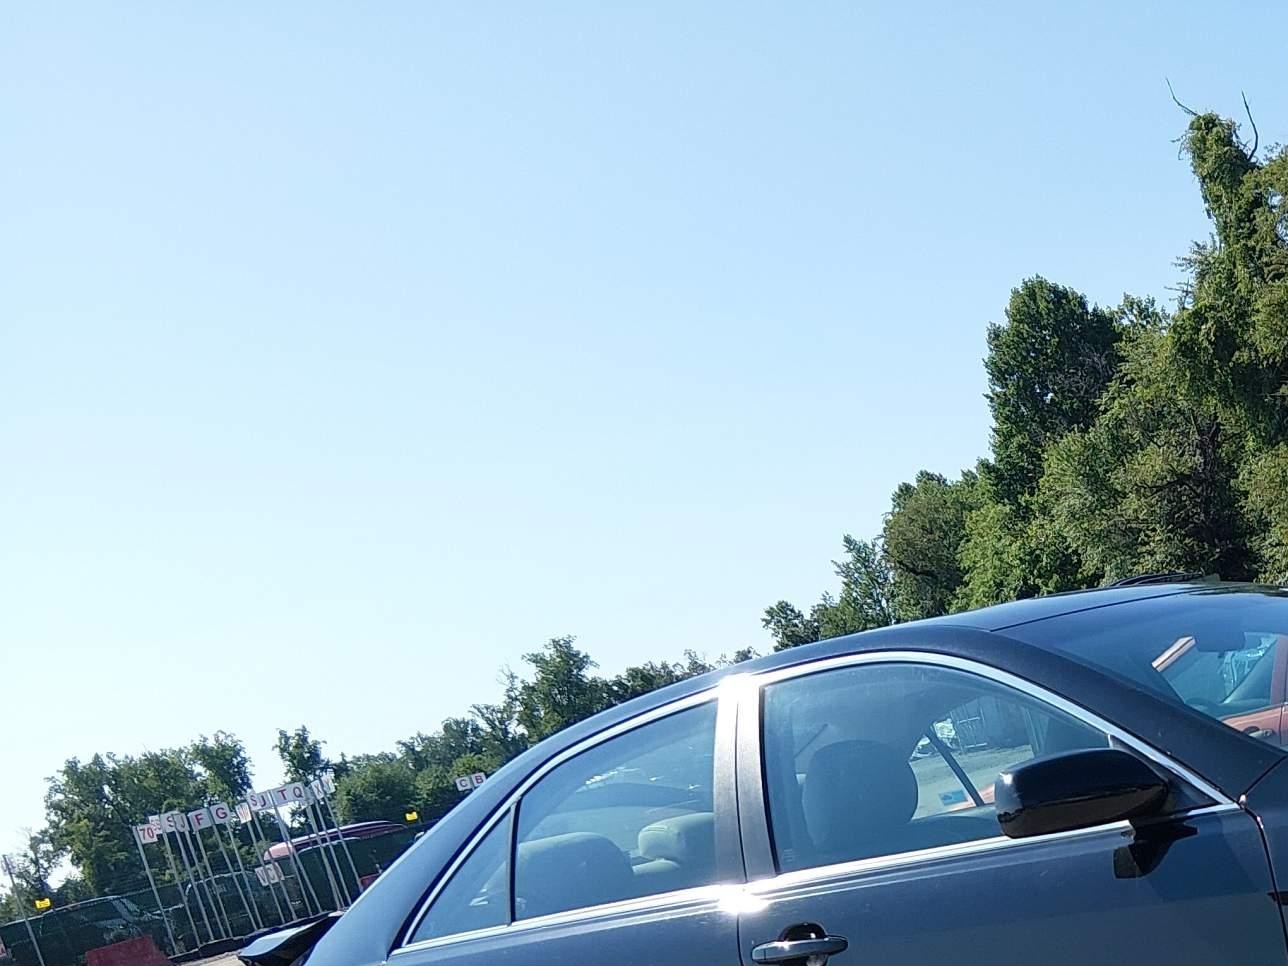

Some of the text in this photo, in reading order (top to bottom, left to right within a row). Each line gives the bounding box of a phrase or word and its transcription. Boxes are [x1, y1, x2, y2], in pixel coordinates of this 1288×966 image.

[459, 779, 468, 788] C
[475, 776, 484, 785] B
[278, 789, 287, 801] T
[293, 786, 304, 799] Q
[250, 795, 258, 807] S
[260, 796, 267, 807] J
[215, 807, 228, 819] G
[195, 813, 204, 826] F
[139, 827, 155, 840] 70
